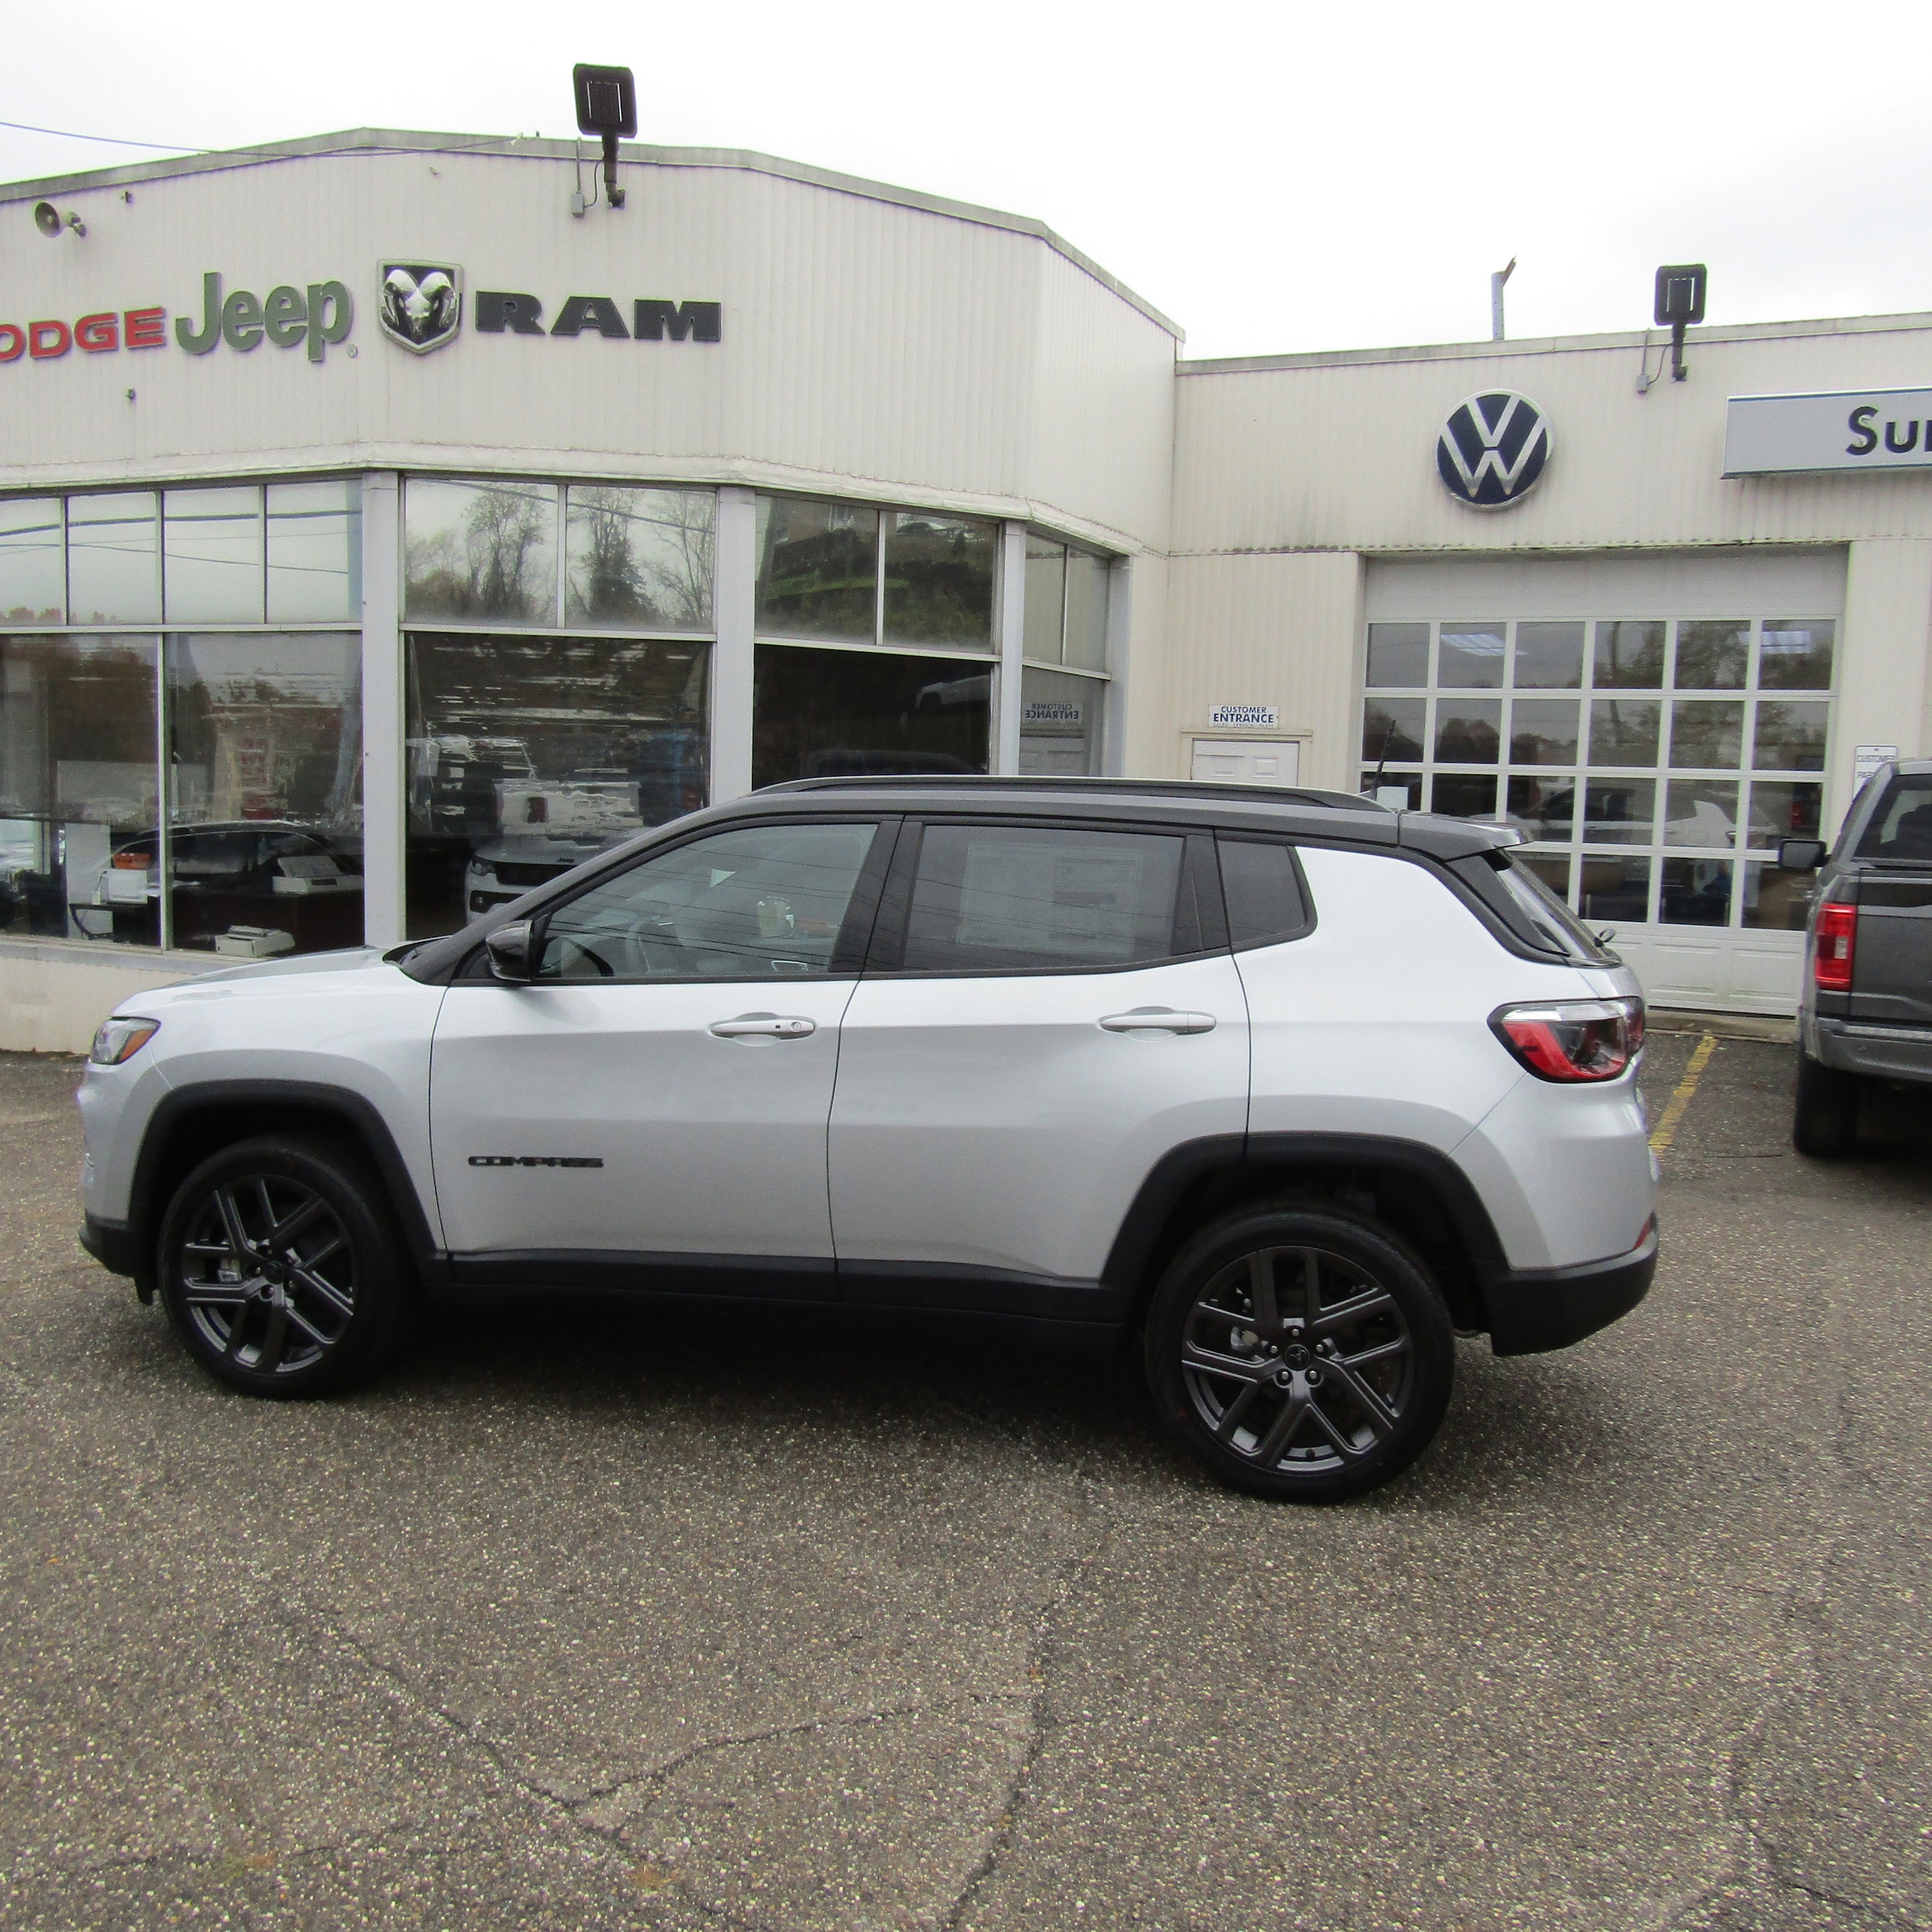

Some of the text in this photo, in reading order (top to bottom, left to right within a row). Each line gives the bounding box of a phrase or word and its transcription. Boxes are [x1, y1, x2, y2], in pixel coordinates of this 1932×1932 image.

[175, 271, 353, 362] Jeep
[475, 291, 723, 342] RAM
[1845, 405, 1932, 456] Su
[1213, 713, 1274, 723] ENTRANCE
